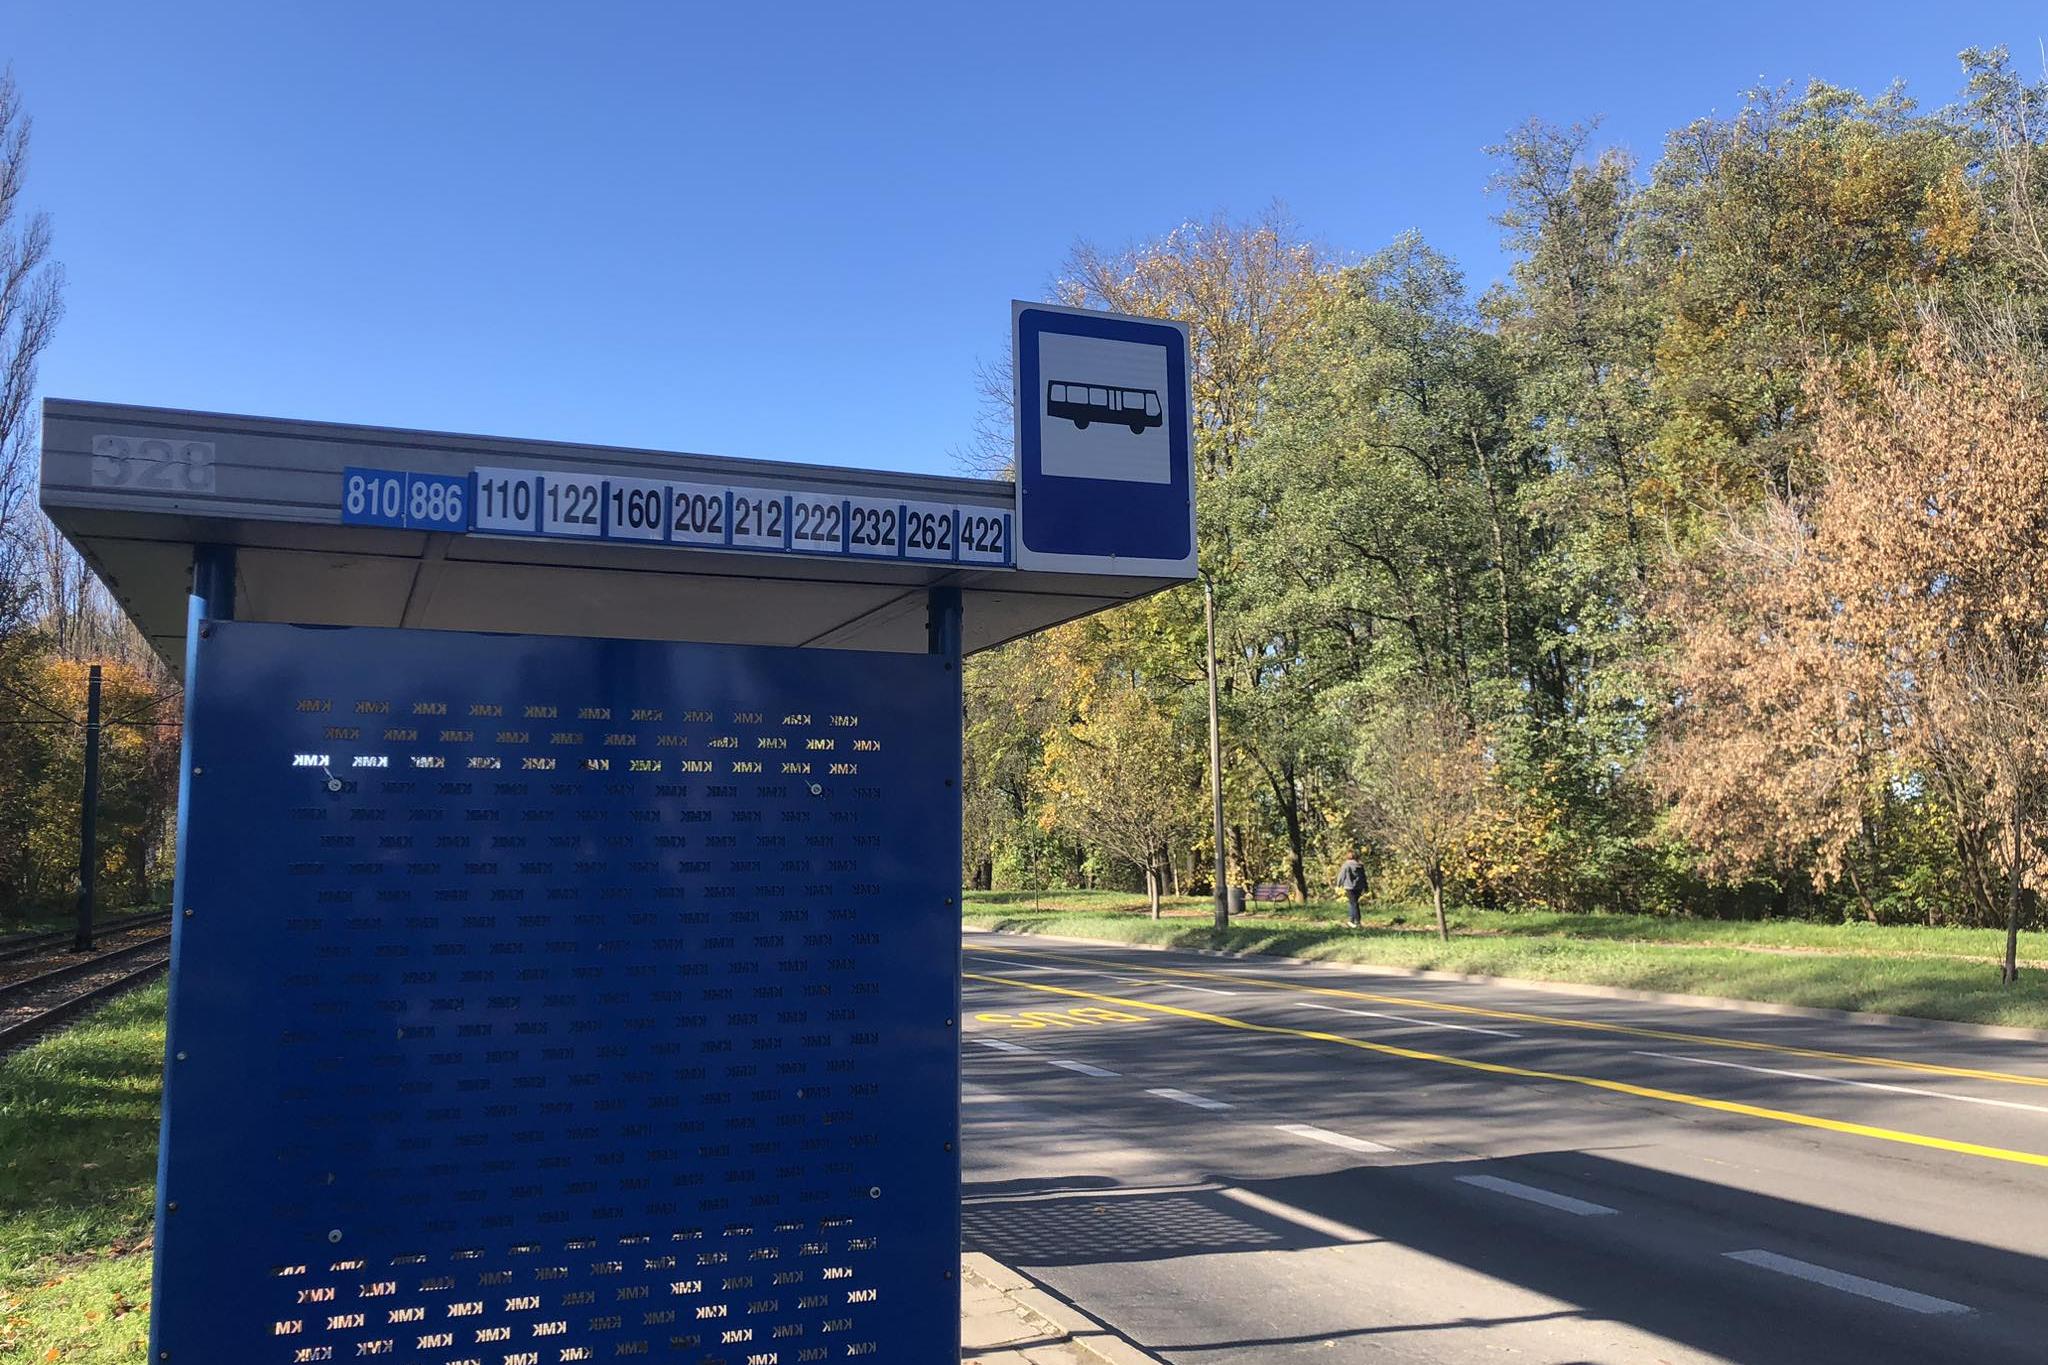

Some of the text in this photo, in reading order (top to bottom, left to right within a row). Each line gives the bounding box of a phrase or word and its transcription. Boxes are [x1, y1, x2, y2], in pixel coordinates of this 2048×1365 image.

[347, 476, 462, 522] 810 886
[482, 479, 1003, 553] 110 122 160 202 212 222 232 262 422
